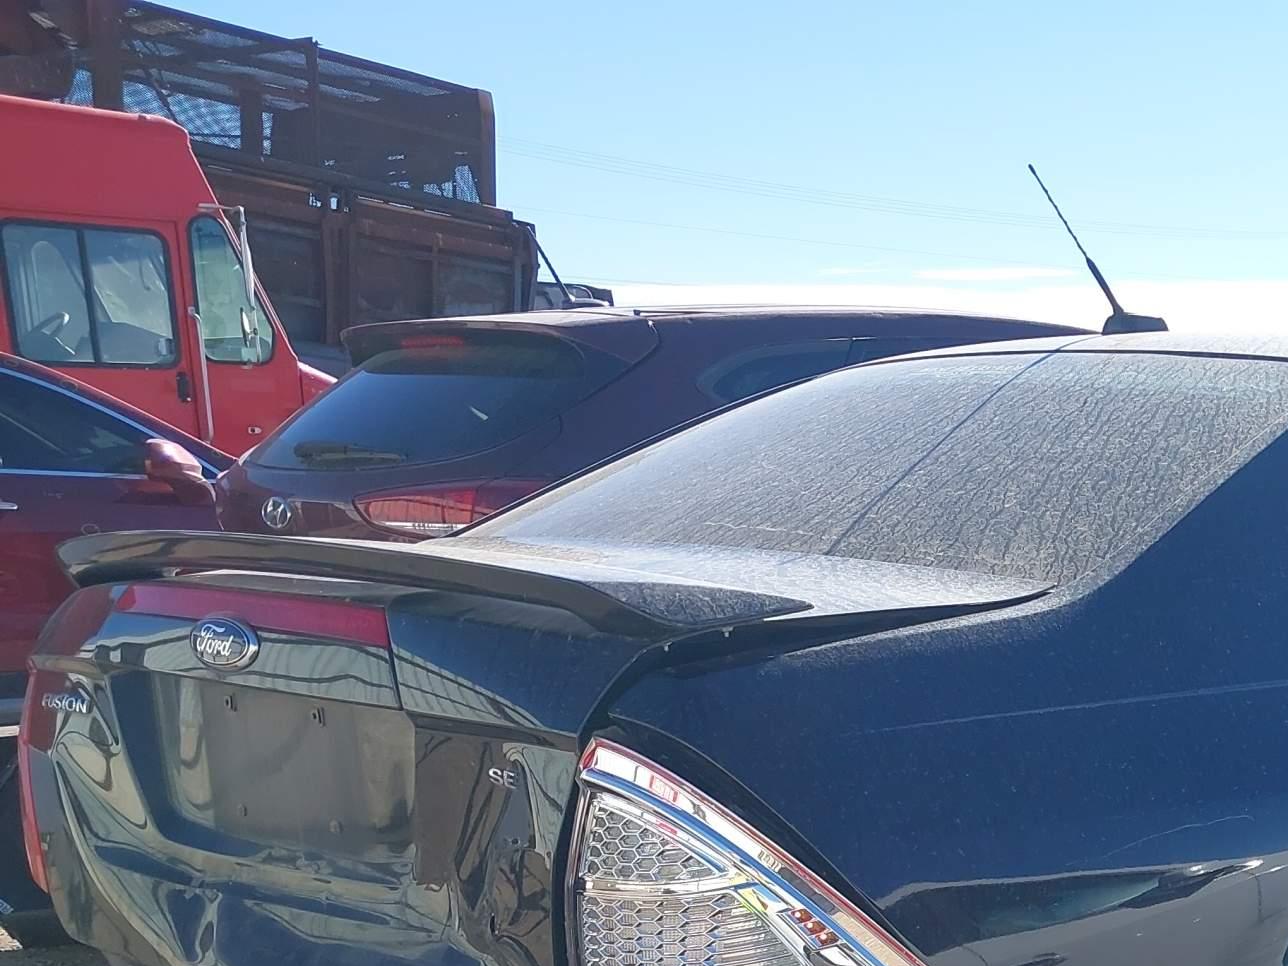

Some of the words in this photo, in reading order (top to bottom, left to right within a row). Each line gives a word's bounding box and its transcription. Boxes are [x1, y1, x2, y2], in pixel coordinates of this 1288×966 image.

[196, 624, 234, 656] Ford
[41, 692, 88, 713] FUSION
[488, 767, 517, 789] SE
